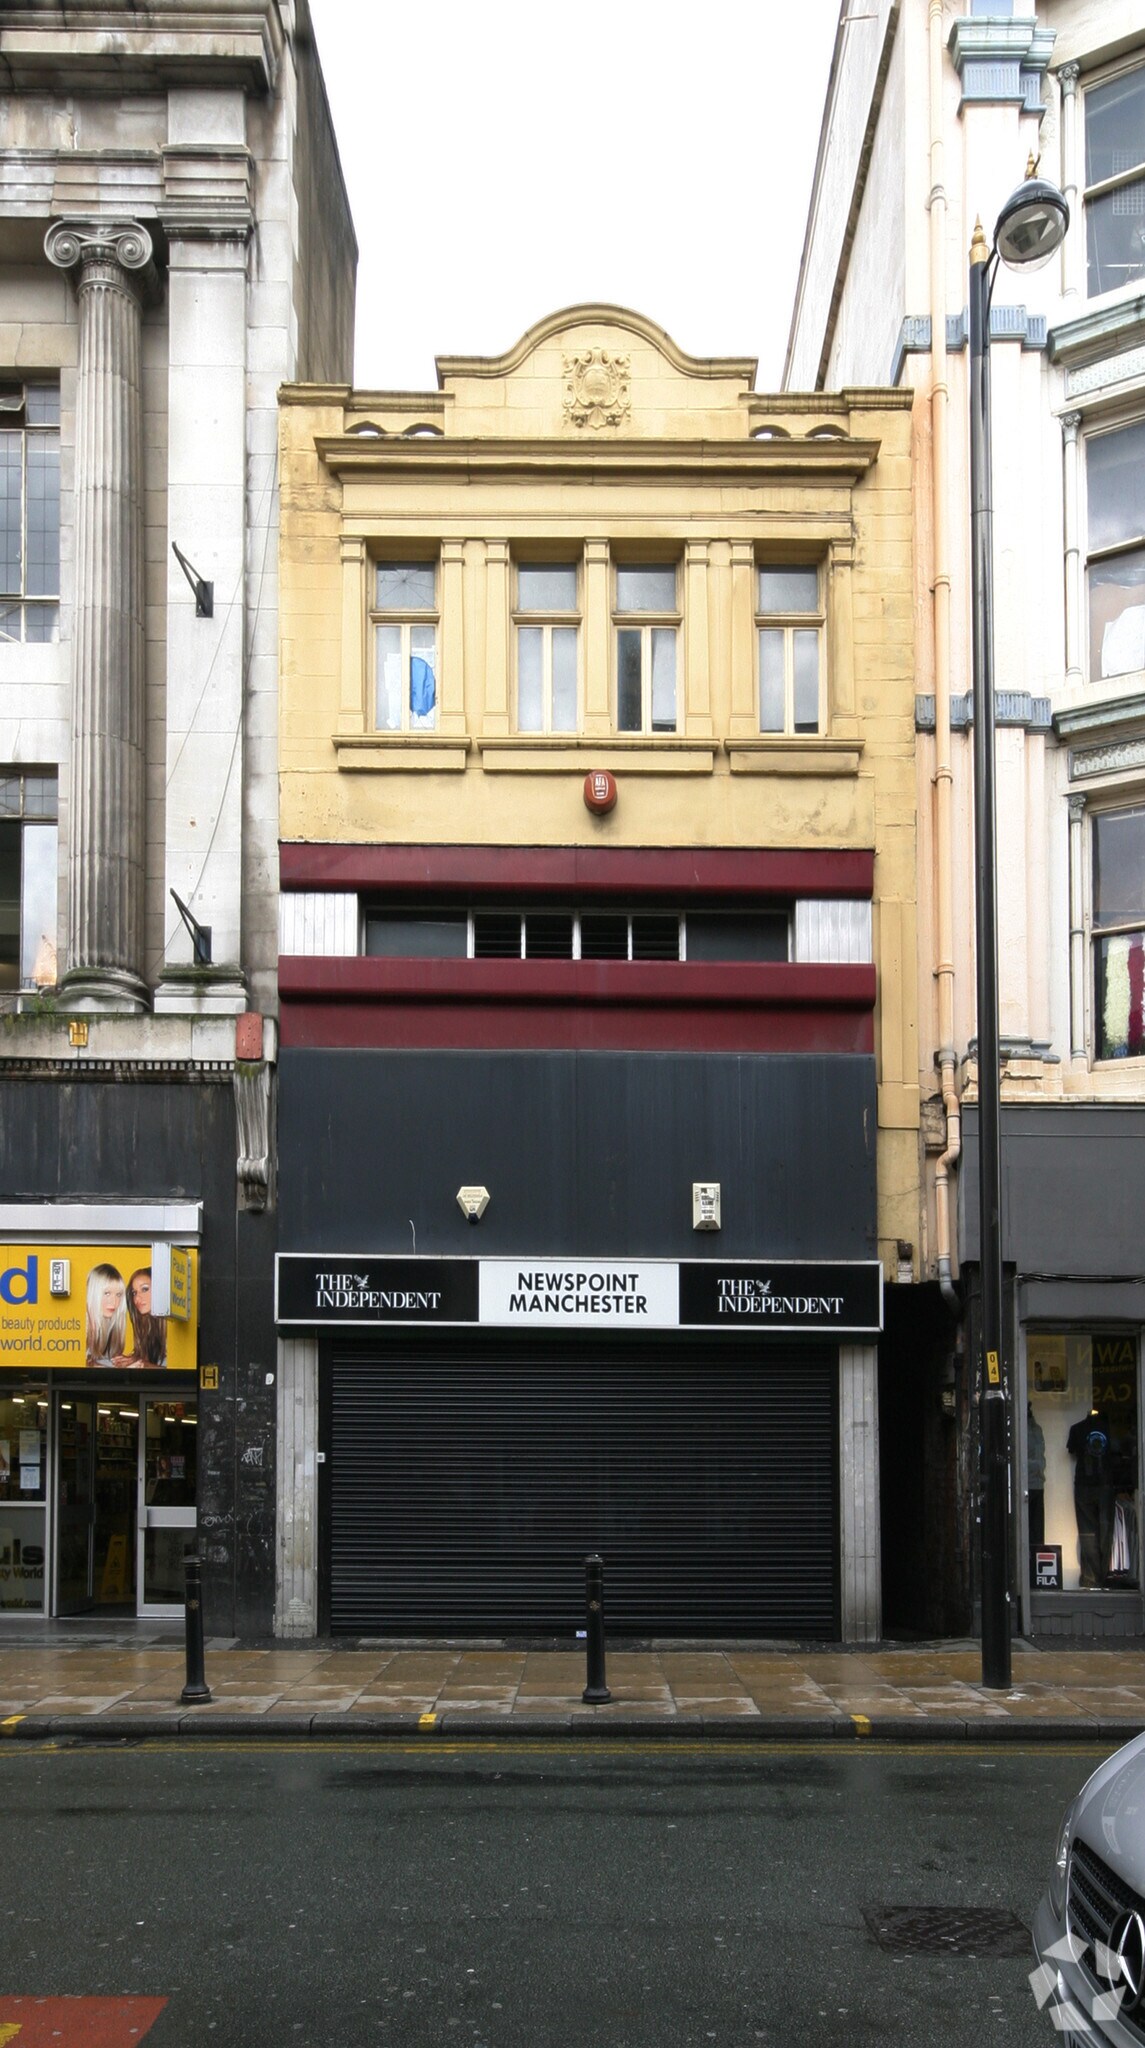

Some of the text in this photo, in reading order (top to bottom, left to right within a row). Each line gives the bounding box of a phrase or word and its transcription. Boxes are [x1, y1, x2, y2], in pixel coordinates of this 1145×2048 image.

[172, 1257, 185, 1275] Pauls
[173, 1275, 184, 1291] Hair
[315, 1273, 354, 1291] THE
[517, 1272, 639, 1293] NEWSPOINT
[717, 1280, 755, 1295] THE
[172, 1293, 186, 1309] World
[315, 1291, 441, 1310] INDEPENDENT
[508, 1293, 649, 1315] MANCHESTER
[717, 1296, 844, 1314] INDEPENDENT
[1, 1316, 81, 1332] beauty products
[202, 1368, 216, 1387] H
[13, 1567, 43, 1579] World
[1036, 1576, 1057, 1585] FILA
